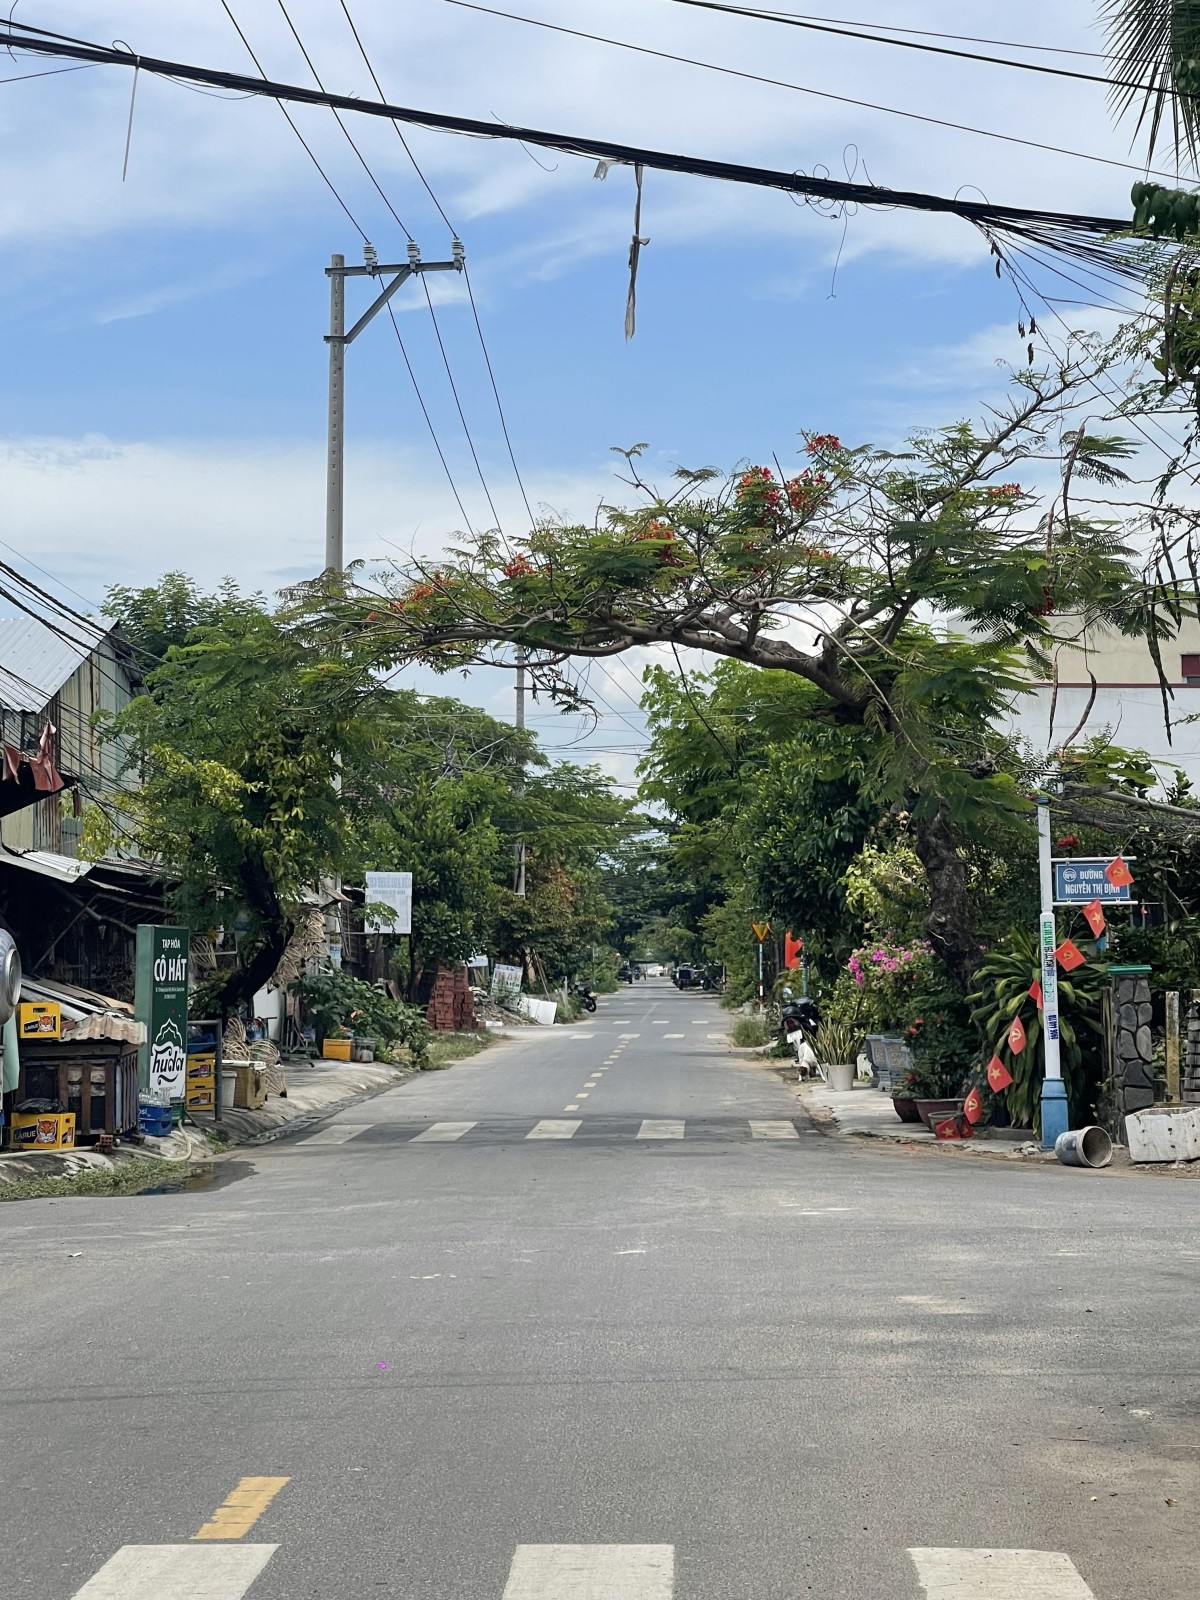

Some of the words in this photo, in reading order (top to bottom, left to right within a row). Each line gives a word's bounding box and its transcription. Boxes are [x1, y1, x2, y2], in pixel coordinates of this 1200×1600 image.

[1080, 868, 1103, 880] ĐƯỜNG
[1092, 883, 1103, 895] THỊ
[161, 938, 170, 951] TẠP
[170, 937, 181, 949] HÓA
[168, 954, 187, 981] HÁT
[152, 1046, 184, 1073] huda
[15, 1130, 37, 1141] LARUE
